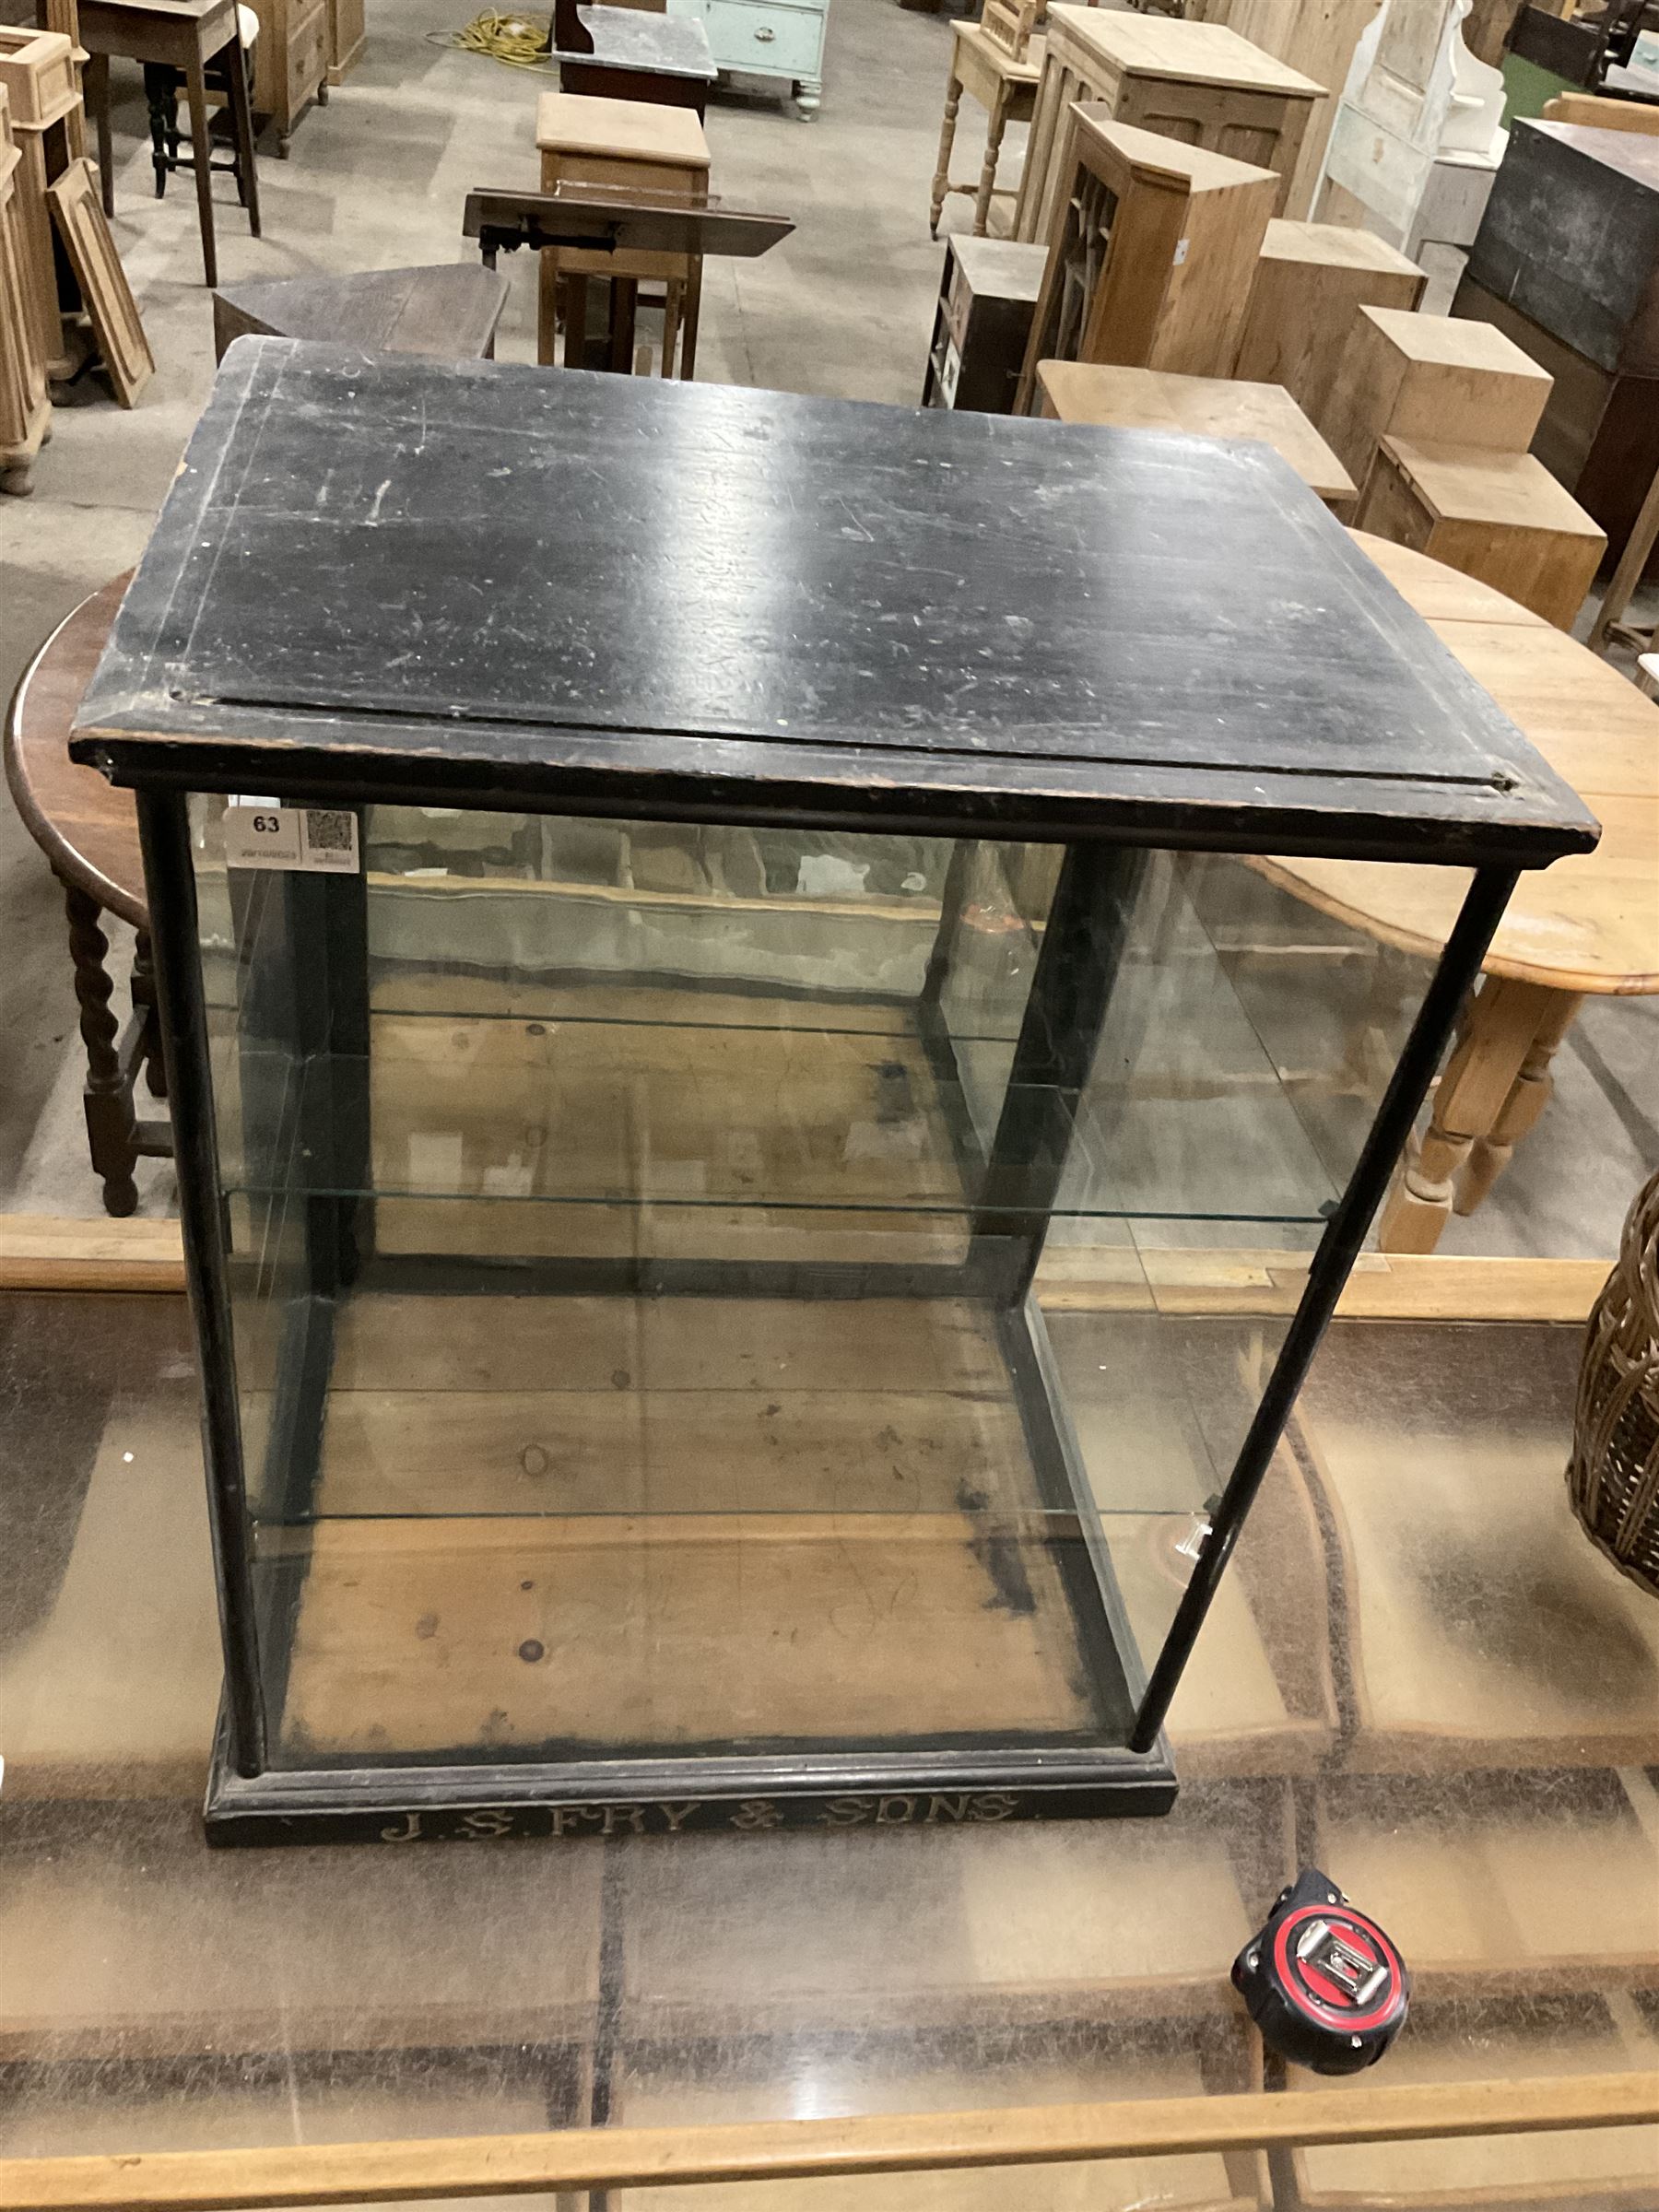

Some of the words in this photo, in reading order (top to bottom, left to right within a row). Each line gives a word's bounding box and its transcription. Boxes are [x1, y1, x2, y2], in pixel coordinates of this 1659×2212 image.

[253, 816, 280, 833] 63
[547, 1802, 701, 1836] FRY
[730, 1797, 782, 1830] &
[818, 1794, 1018, 1826] SONS
